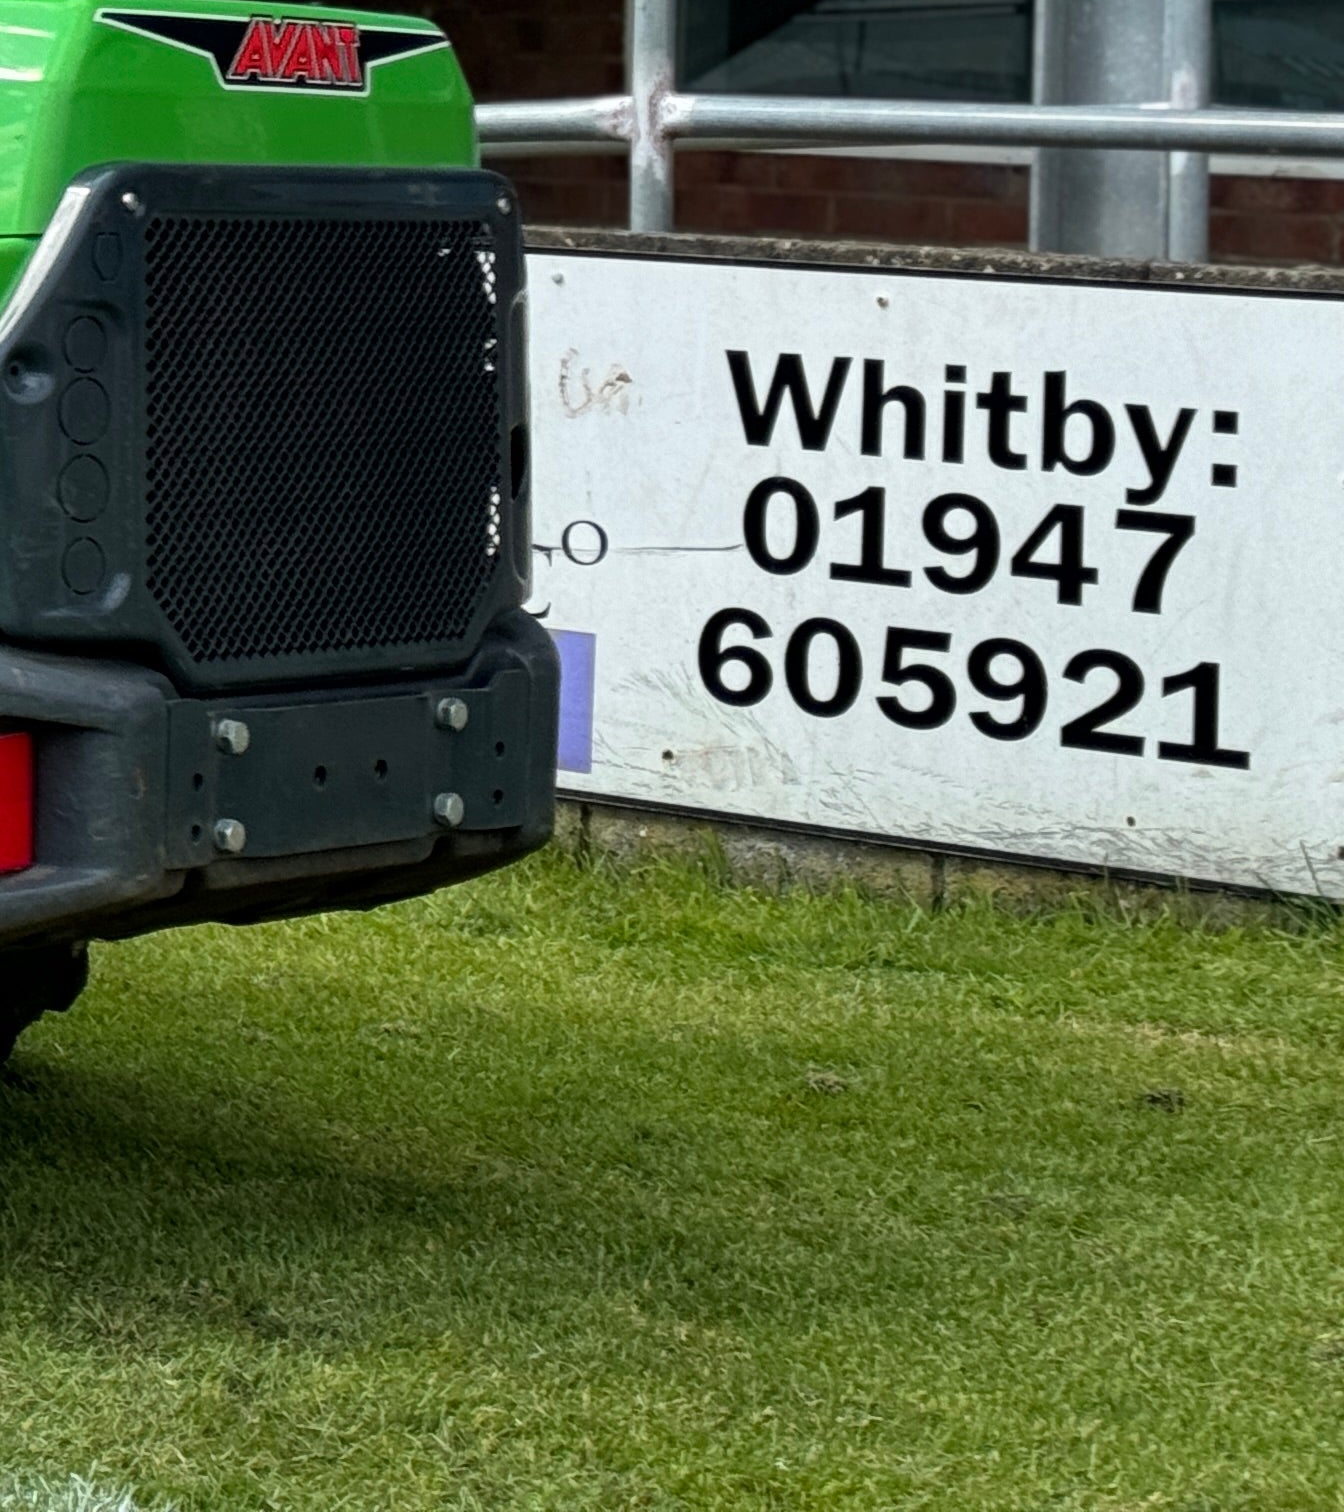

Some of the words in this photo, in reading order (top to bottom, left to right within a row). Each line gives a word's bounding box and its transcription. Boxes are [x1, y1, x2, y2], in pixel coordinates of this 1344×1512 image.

[226, 16, 364, 87] AVANT
[726, 349, 1240, 506] Whitby:
[743, 475, 1197, 616] 01947
[698, 607, 1250, 771] 605921
